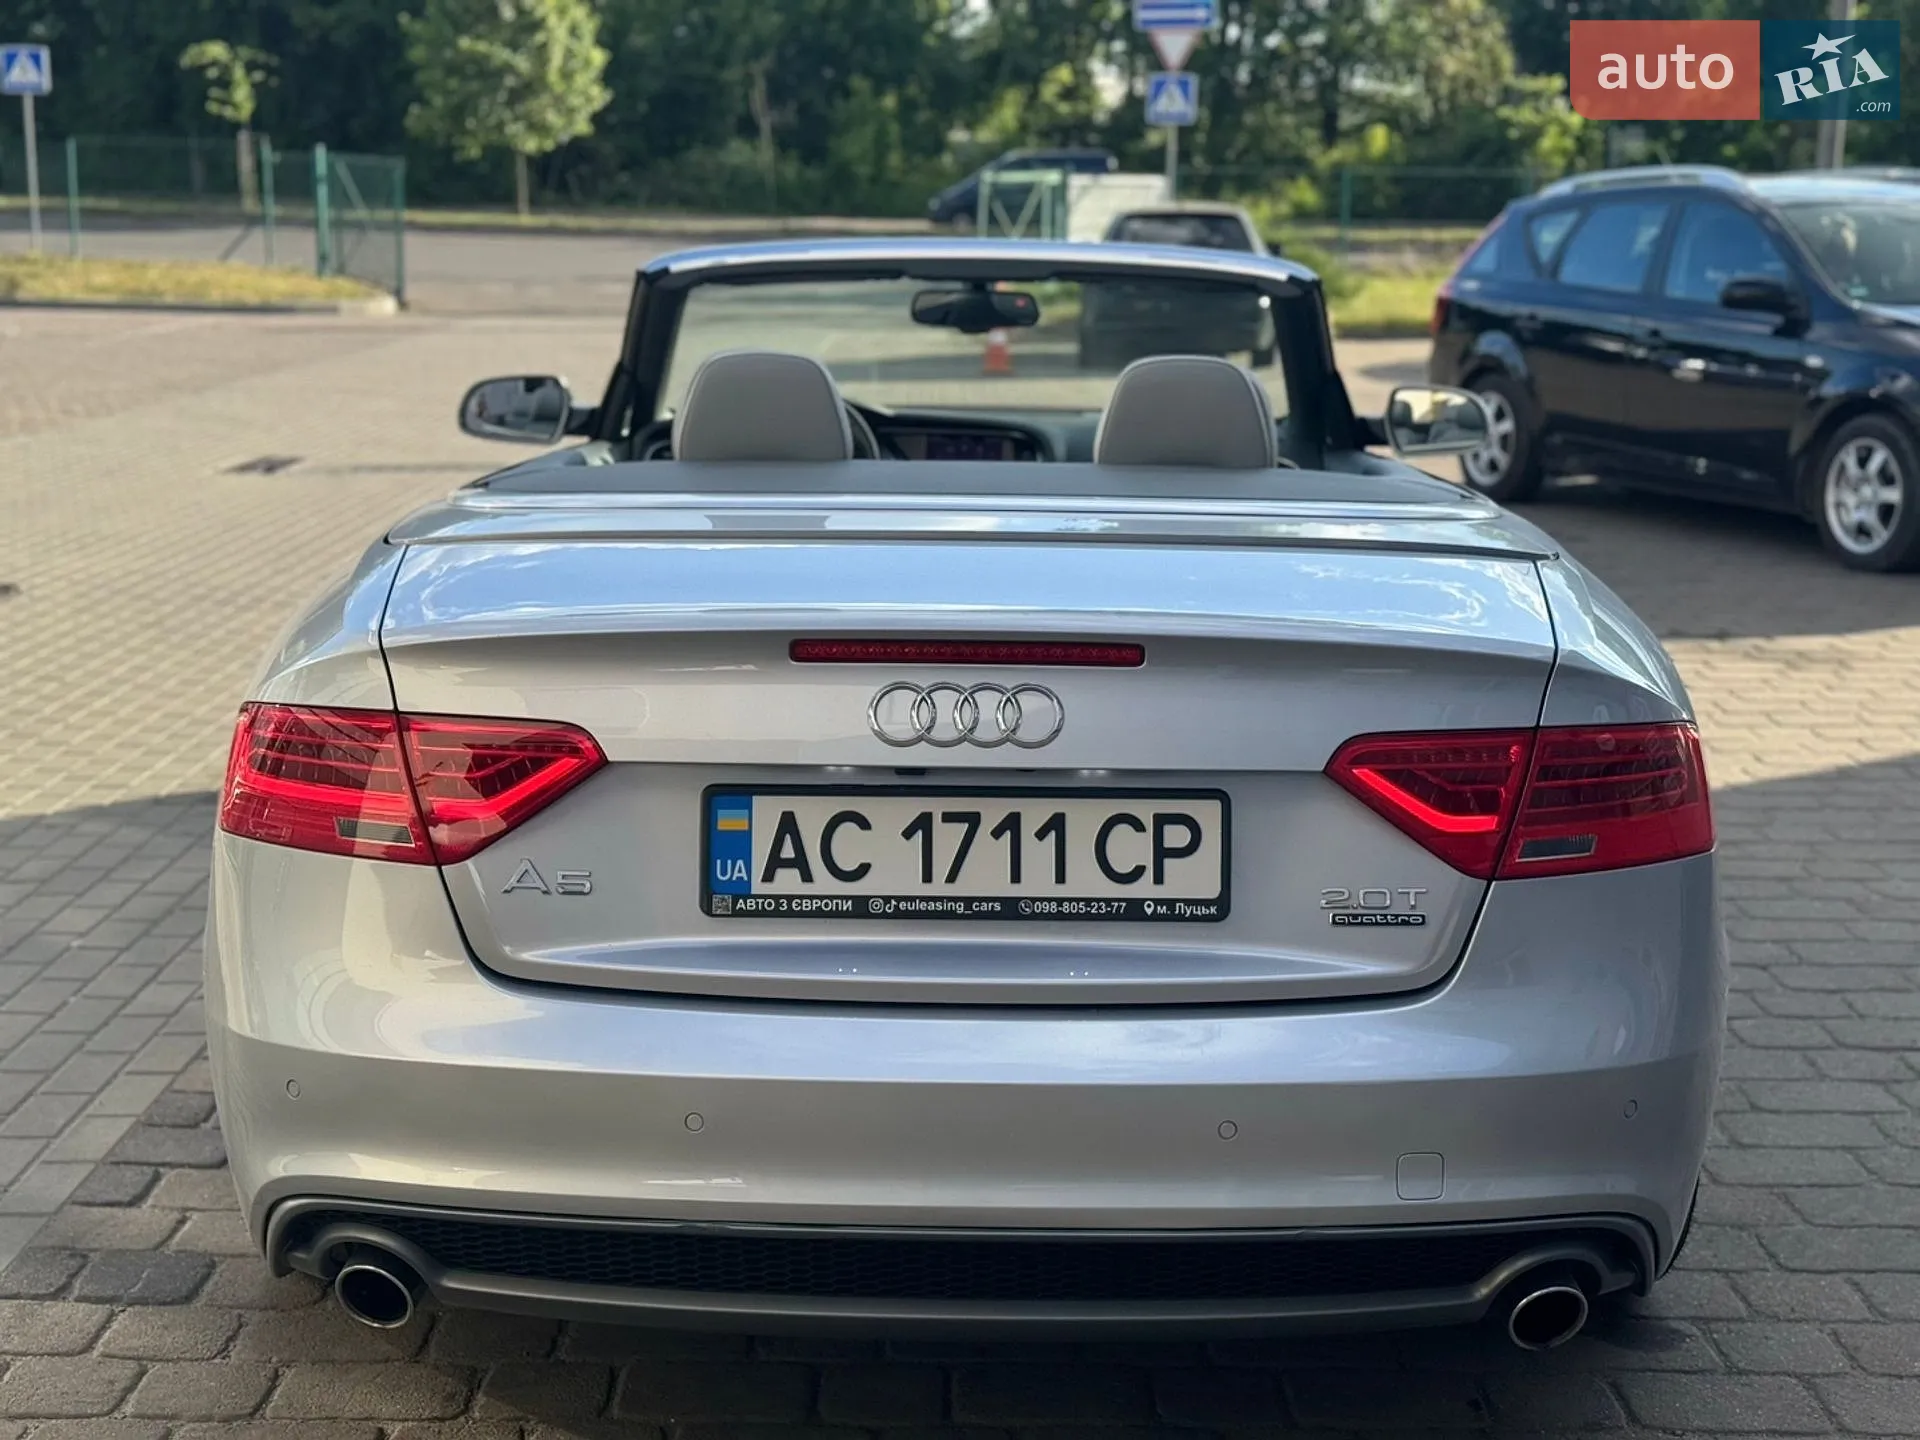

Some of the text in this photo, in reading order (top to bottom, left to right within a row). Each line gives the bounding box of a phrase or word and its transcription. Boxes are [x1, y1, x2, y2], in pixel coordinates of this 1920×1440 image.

[761, 810, 1203, 886] AC 1711 CP
[501, 857, 592, 896] A5
[716, 858, 748, 882] UA
[735, 899, 775, 911] АВТО
[792, 899, 852, 912] ЄВРОПИ
[1320, 887, 1427, 910] 2.0T
[899, 900, 1001, 913] euleasing_cars
[1034, 901, 1127, 914] 098-805-23-77
[1174, 903, 1218, 917] Луцьк
[1335, 914, 1423, 925] quattro
